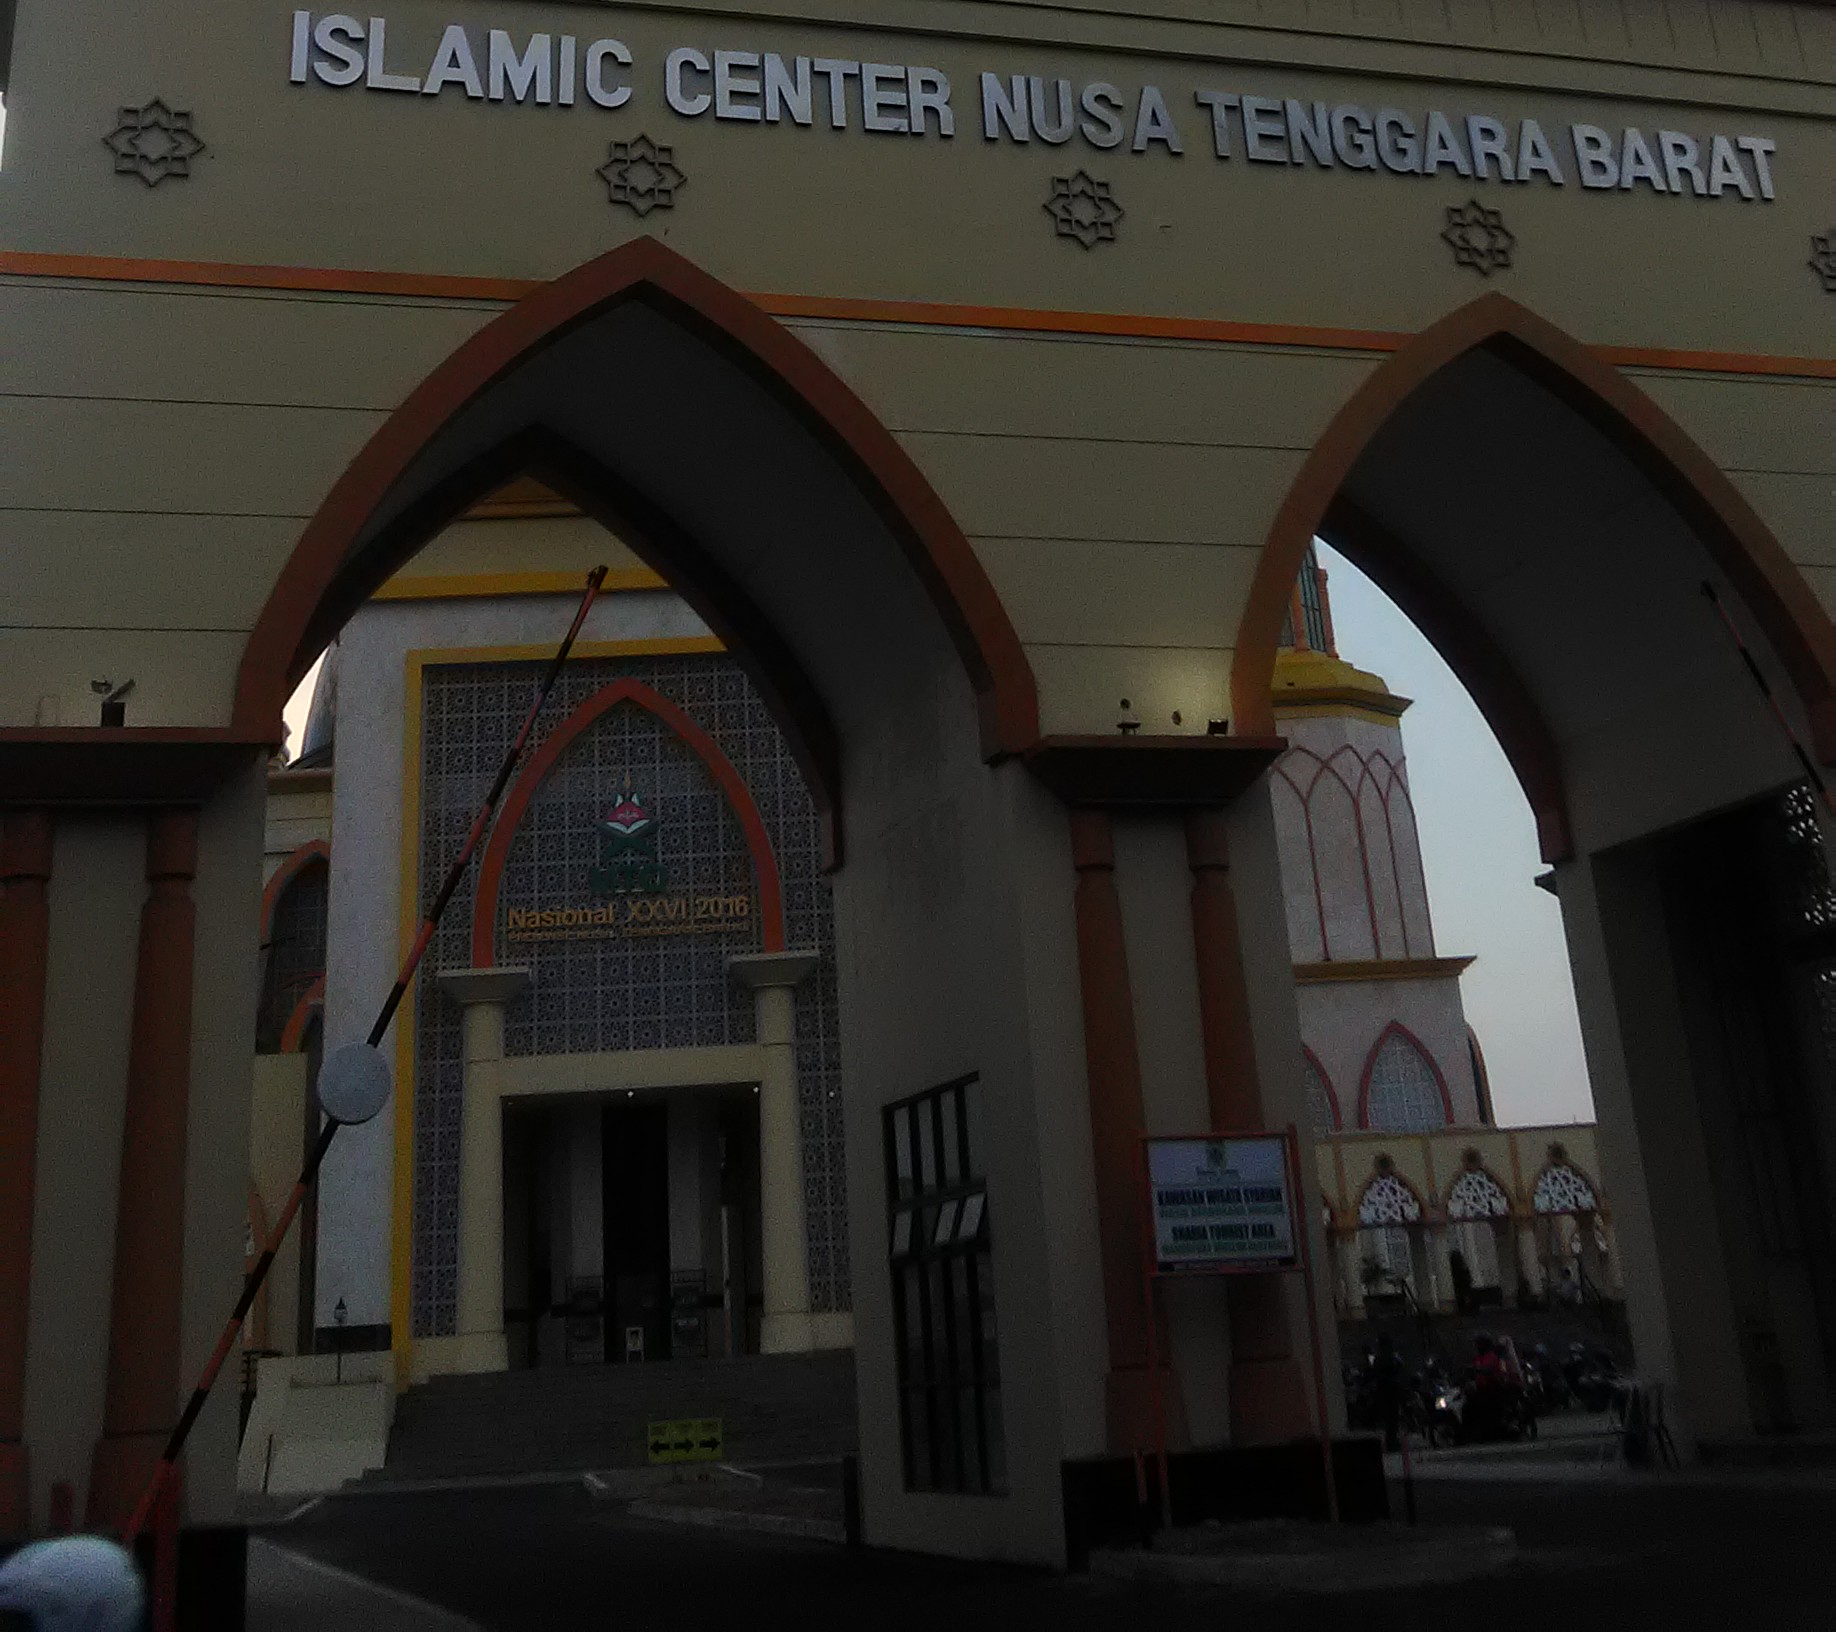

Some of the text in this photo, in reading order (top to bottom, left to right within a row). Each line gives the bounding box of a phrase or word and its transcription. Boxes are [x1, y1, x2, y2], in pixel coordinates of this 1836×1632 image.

[290, 9, 1777, 201] ISLAMIC CENTER NUSA TENGGARA BARAT
[507, 895, 749, 930] Nasional XXVI 2016
